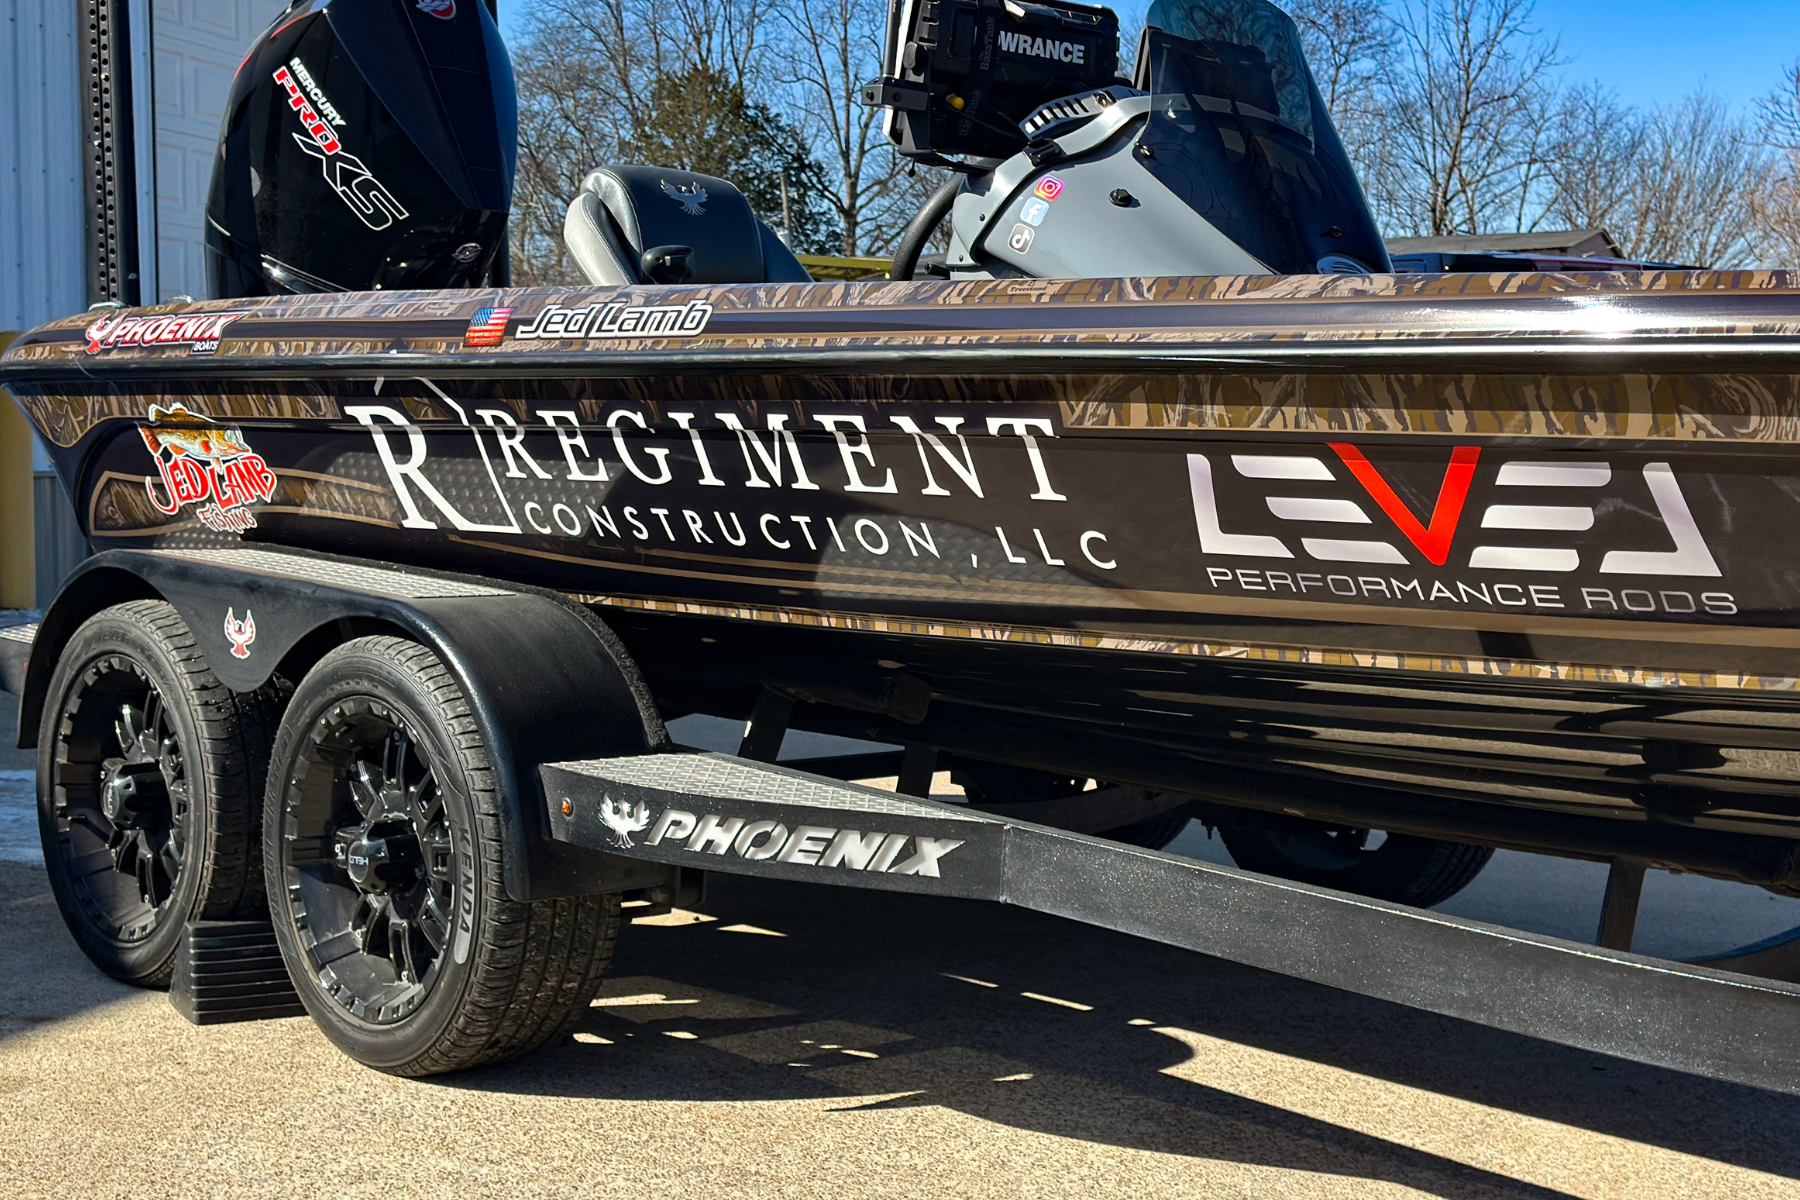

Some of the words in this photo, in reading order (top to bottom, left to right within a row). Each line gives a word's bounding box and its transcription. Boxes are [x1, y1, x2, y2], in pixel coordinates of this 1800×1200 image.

[975, 27, 1085, 64] WRANCE
[980, 17, 995, 71] BassTank
[272, 65, 342, 156] PRO
[289, 57, 347, 127] MERCURY
[959, 89, 982, 137] BasTank
[292, 116, 410, 231] XS
[103, 312, 248, 346] PHOENIX
[194, 340, 219, 351] BOATS
[146, 454, 211, 515] JED
[205, 453, 277, 511] LAMB
[475, 408, 1068, 502] REGIMENT
[1186, 442, 1723, 577] LEVEL
[1206, 567, 1565, 609] PERFORMANCE
[1581, 587, 1738, 616] RODS
[643, 808, 966, 879] PHOENIX
[458, 824, 473, 934] KENDA
